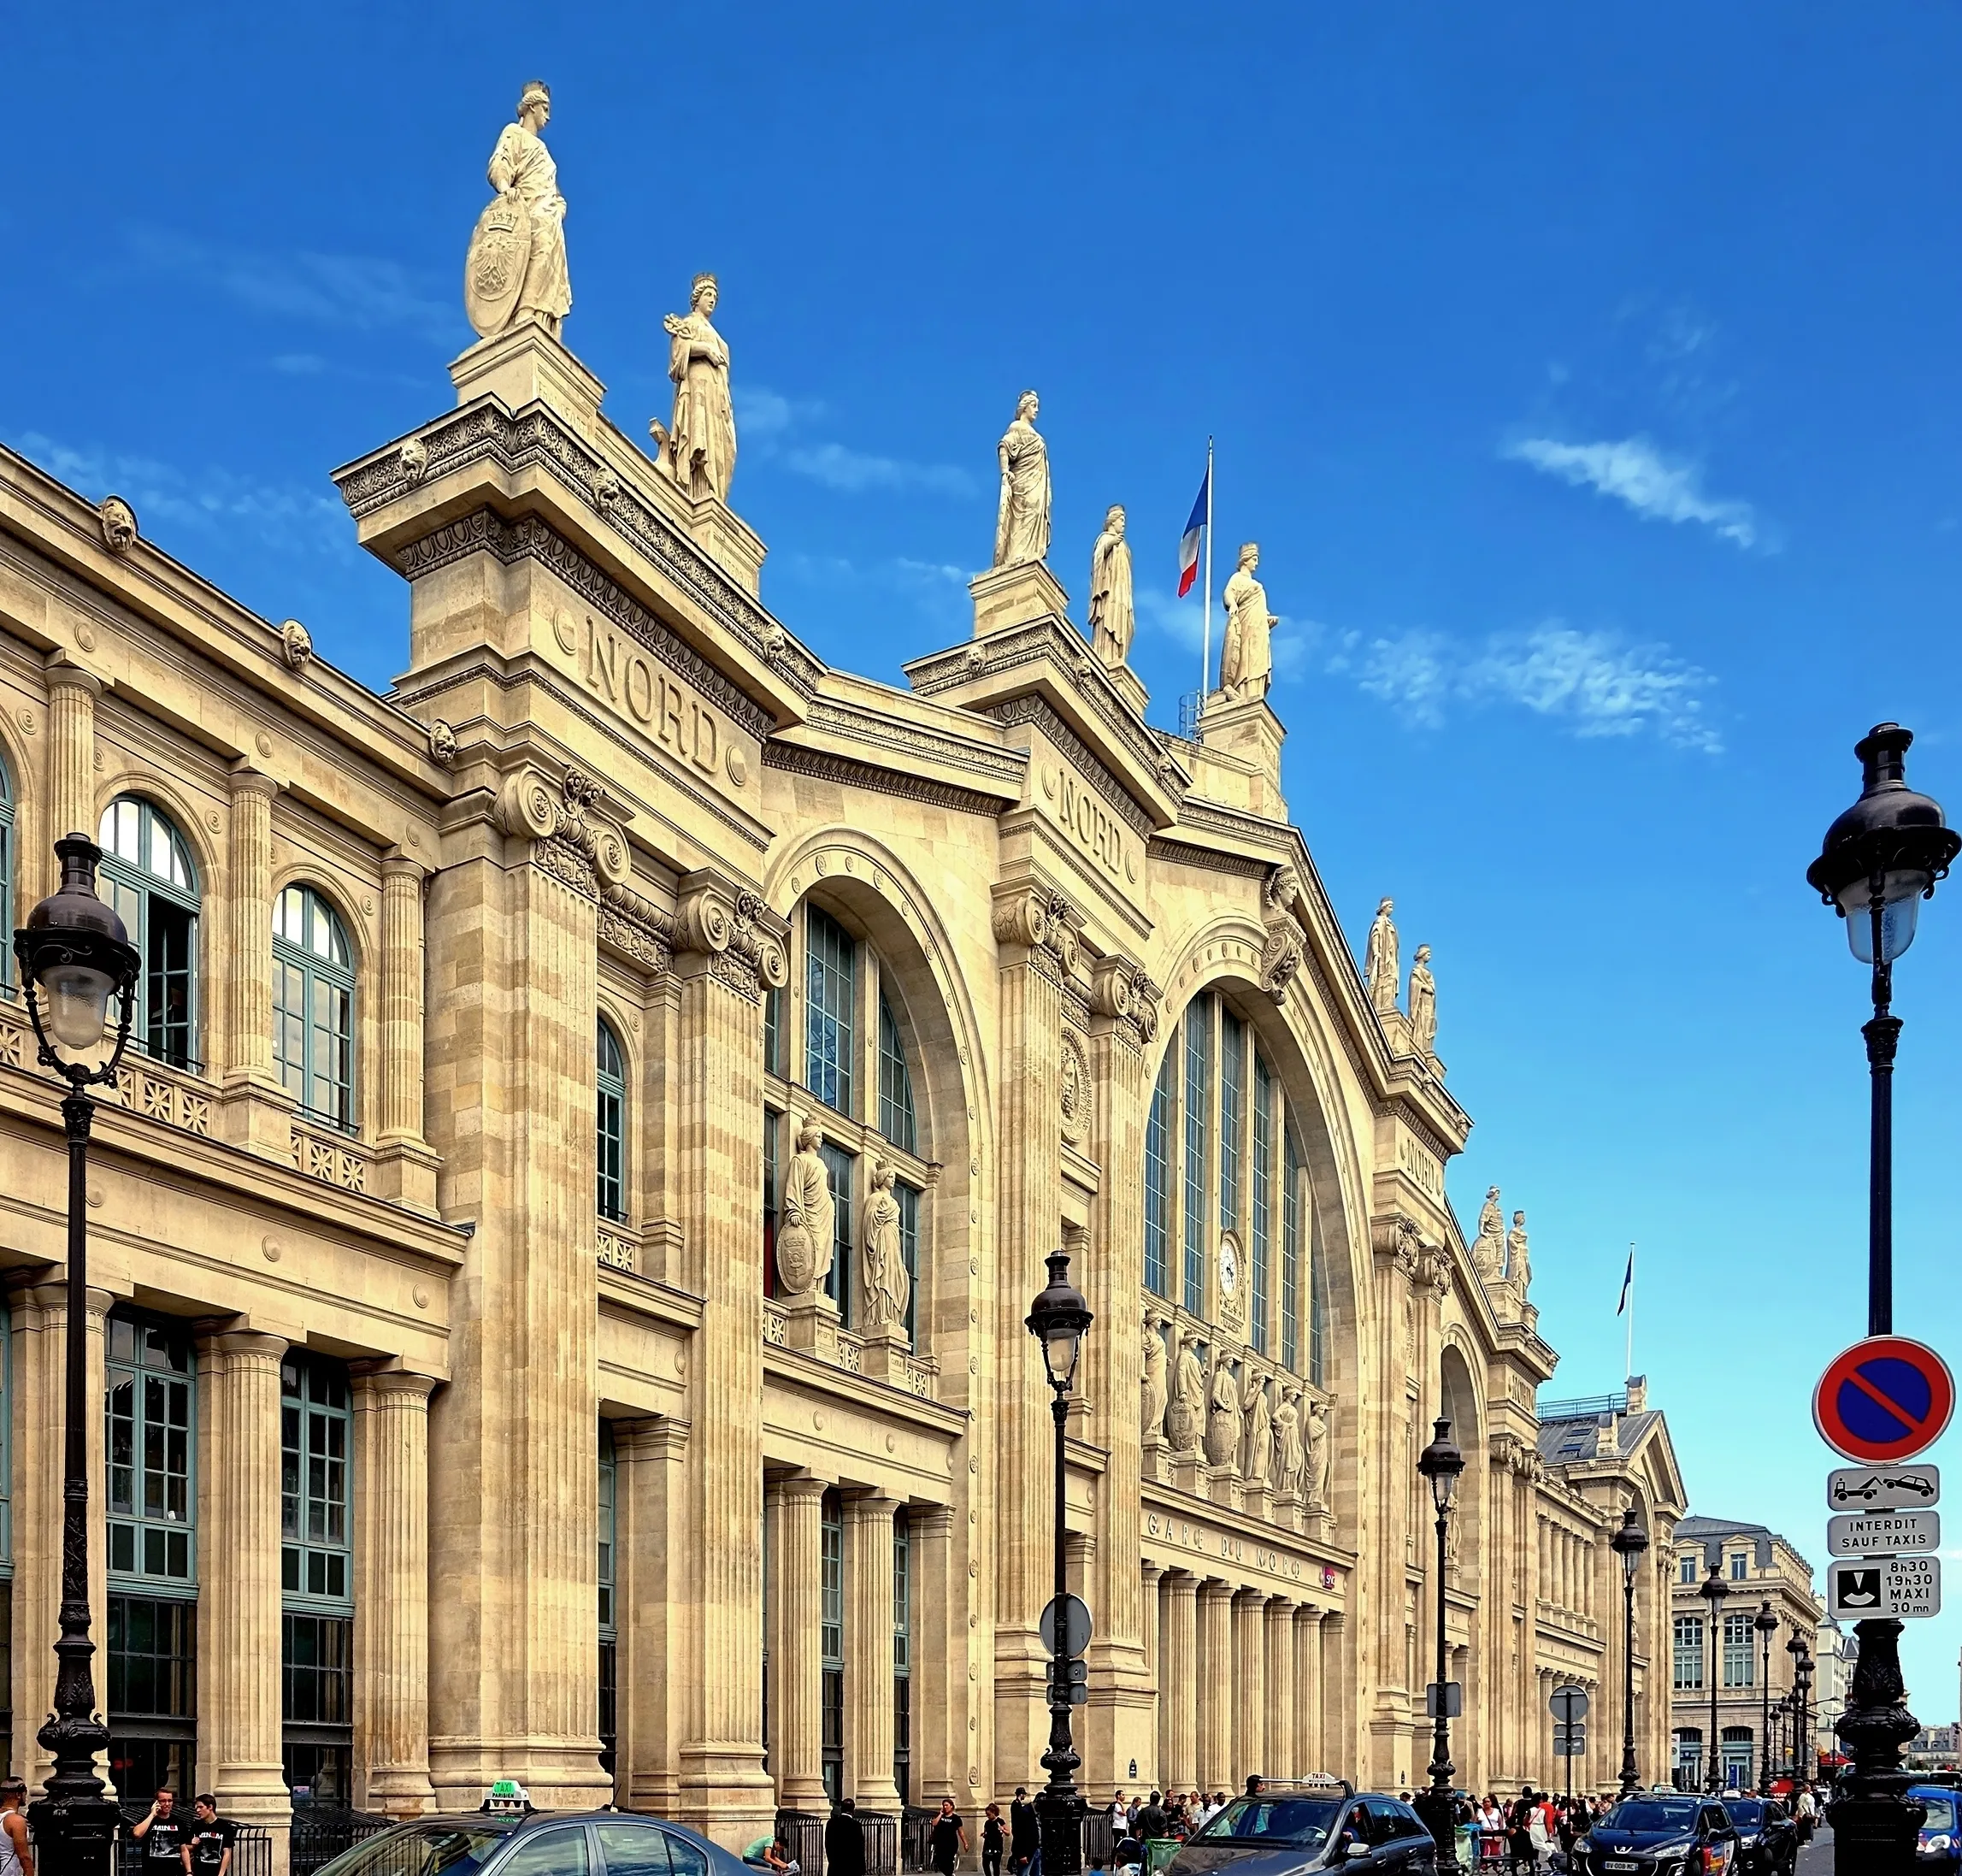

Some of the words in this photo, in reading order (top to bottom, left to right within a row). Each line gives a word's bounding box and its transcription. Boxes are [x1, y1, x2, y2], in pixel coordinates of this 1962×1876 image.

[586, 615, 720, 775] NORD
[1058, 767, 1122, 876] NORD
[1406, 1136, 1435, 1195] NORD
[1849, 1519, 1917, 1532] INTERDIT
[1147, 1513, 1204, 1550] GARE
[1221, 1536, 1243, 1562] DU
[1256, 1547, 1301, 1579] NORD
[1841, 1536, 1879, 1548] SAUF
[1885, 1534, 1926, 1546] TAXIS
[1890, 1560, 1928, 1572] 8h30
[1886, 1573, 1933, 1586] 19h30
[1889, 1588, 1930, 1600] MAXI
[1890, 1602, 1910, 1613] 30
[495, 1782, 512, 1793] TAXI
